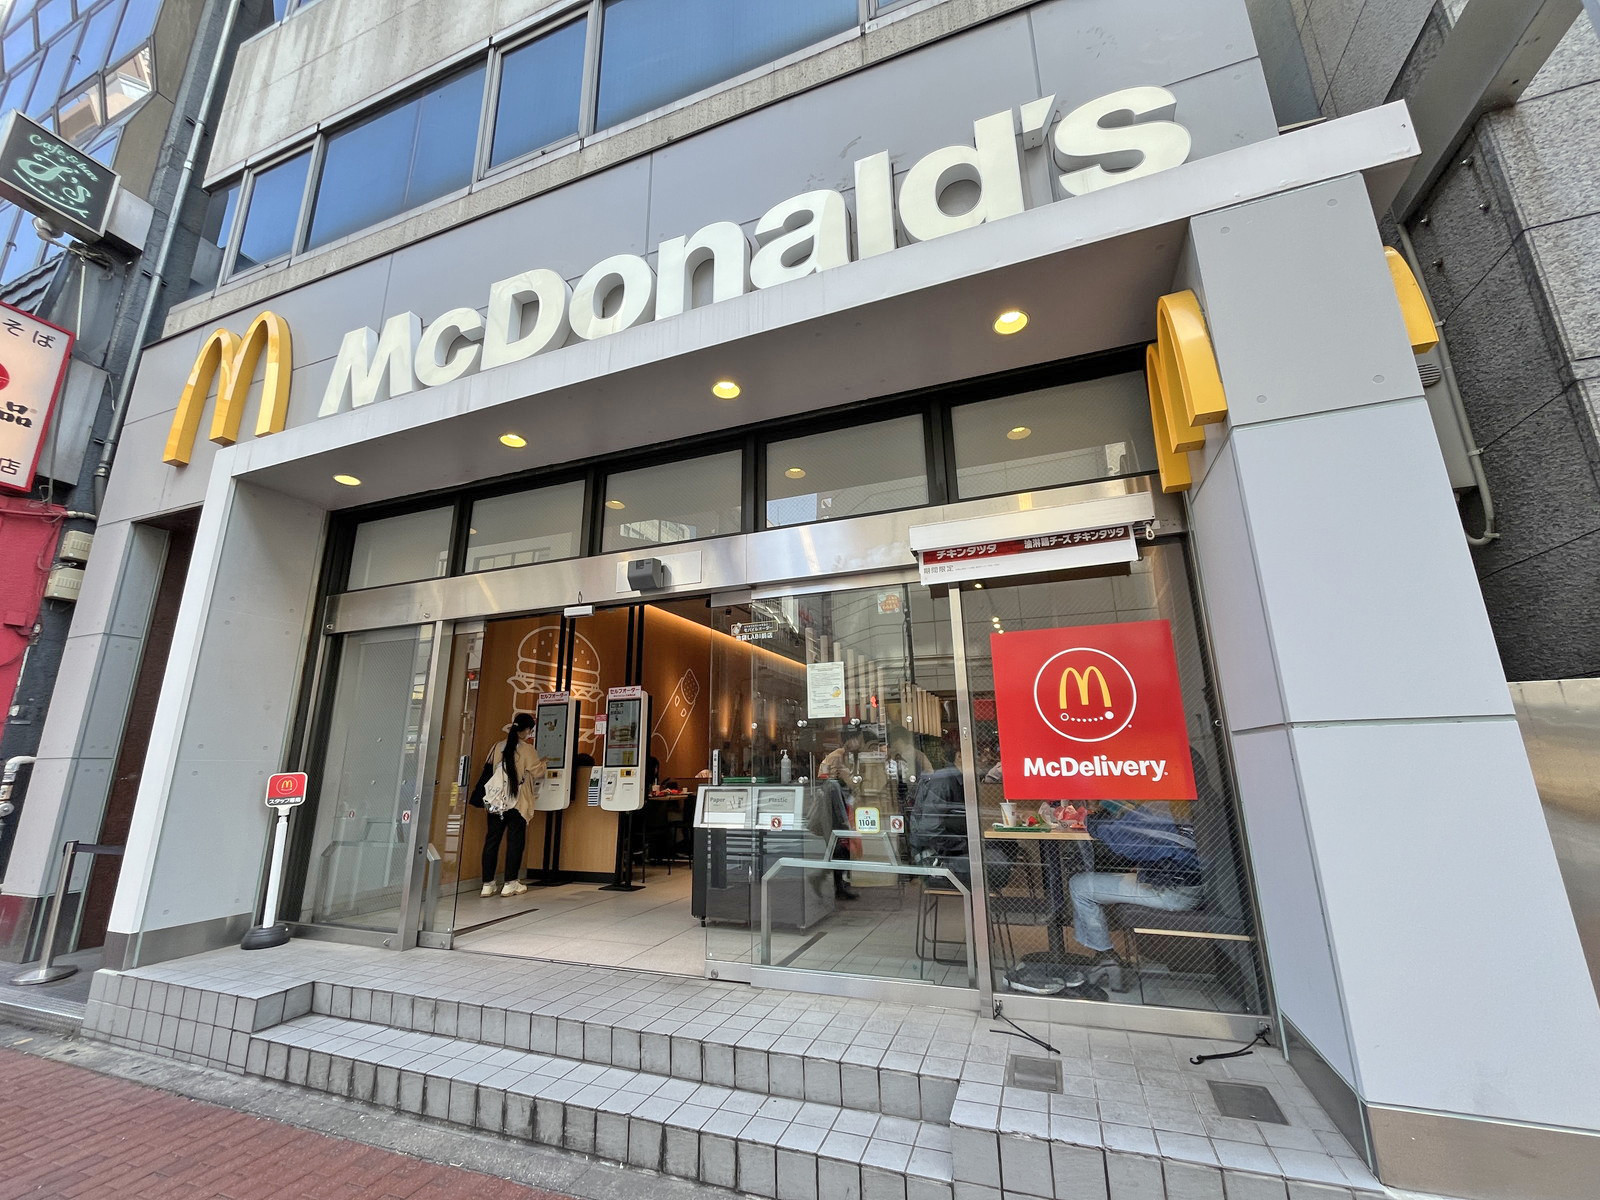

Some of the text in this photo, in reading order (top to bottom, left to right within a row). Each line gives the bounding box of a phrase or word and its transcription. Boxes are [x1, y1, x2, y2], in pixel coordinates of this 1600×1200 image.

[317, 86, 1192, 418] McDonald's
[3, 318, 56, 349] そば
[1073, 527, 1125, 543] チキンタツタ
[936, 543, 998, 560] チキンタツタ
[923, 564, 954, 575] 期間限定
[609, 687, 640, 695] セルフオーダー
